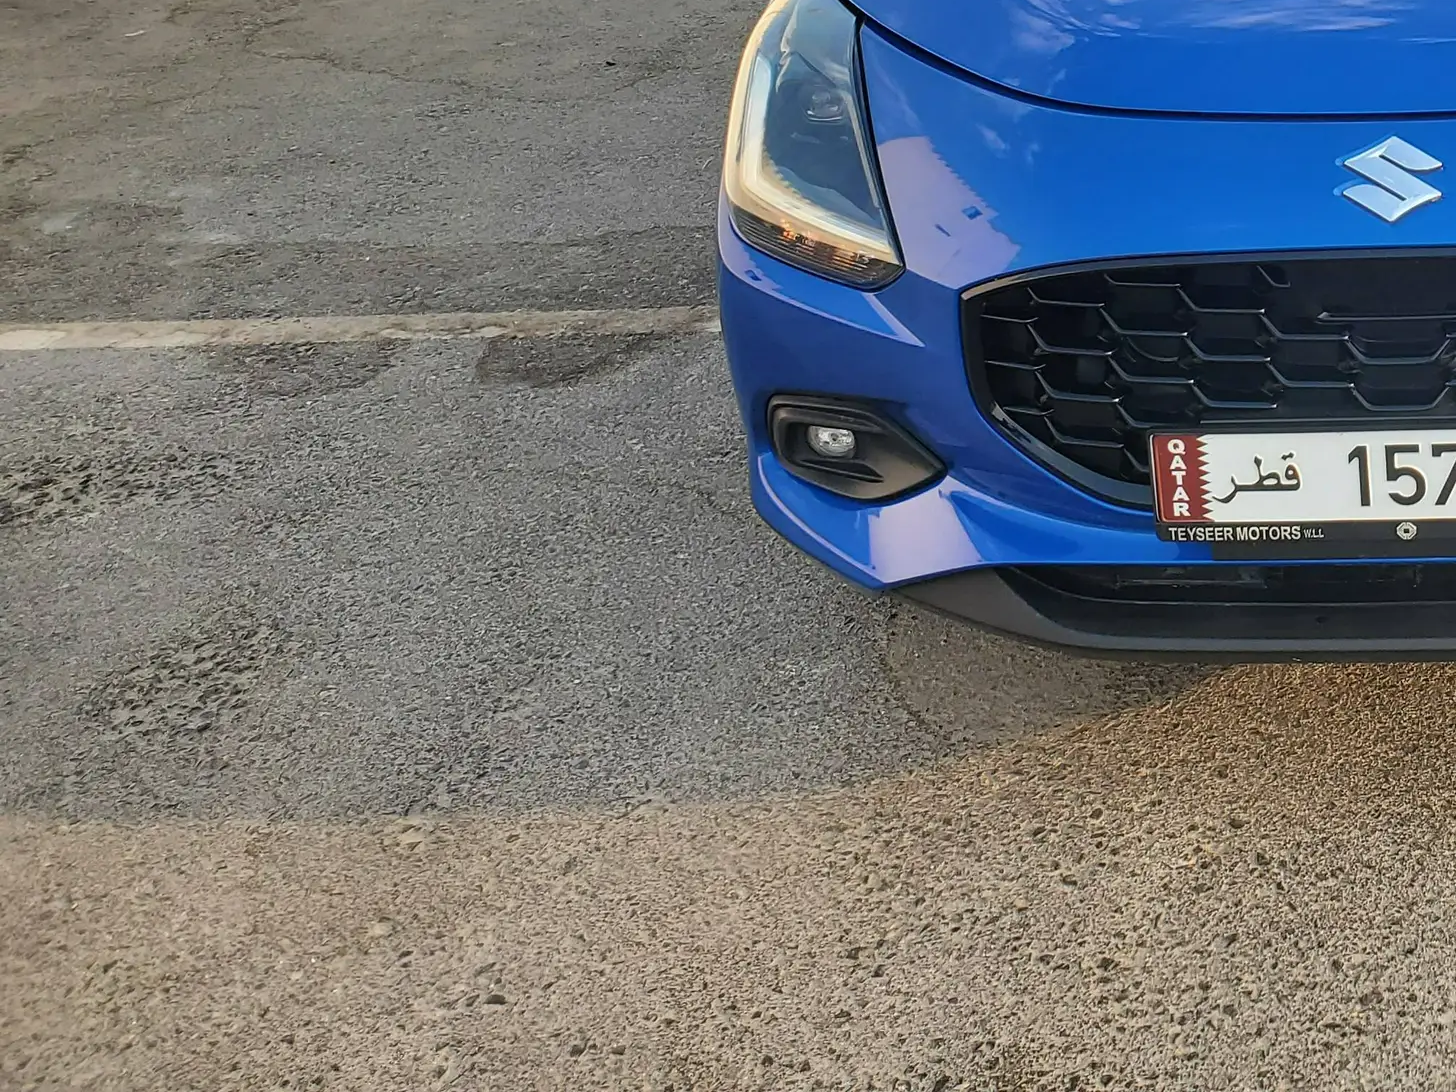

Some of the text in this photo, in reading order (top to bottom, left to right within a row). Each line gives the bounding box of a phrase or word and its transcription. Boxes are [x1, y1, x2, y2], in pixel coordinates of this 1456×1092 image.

[1167, 439, 1191, 517] QATAR
[1212, 452, 1301, 503] قطر
[1168, 527, 1234, 541] TEYSEER
[1236, 525, 1301, 541] MOTORS
